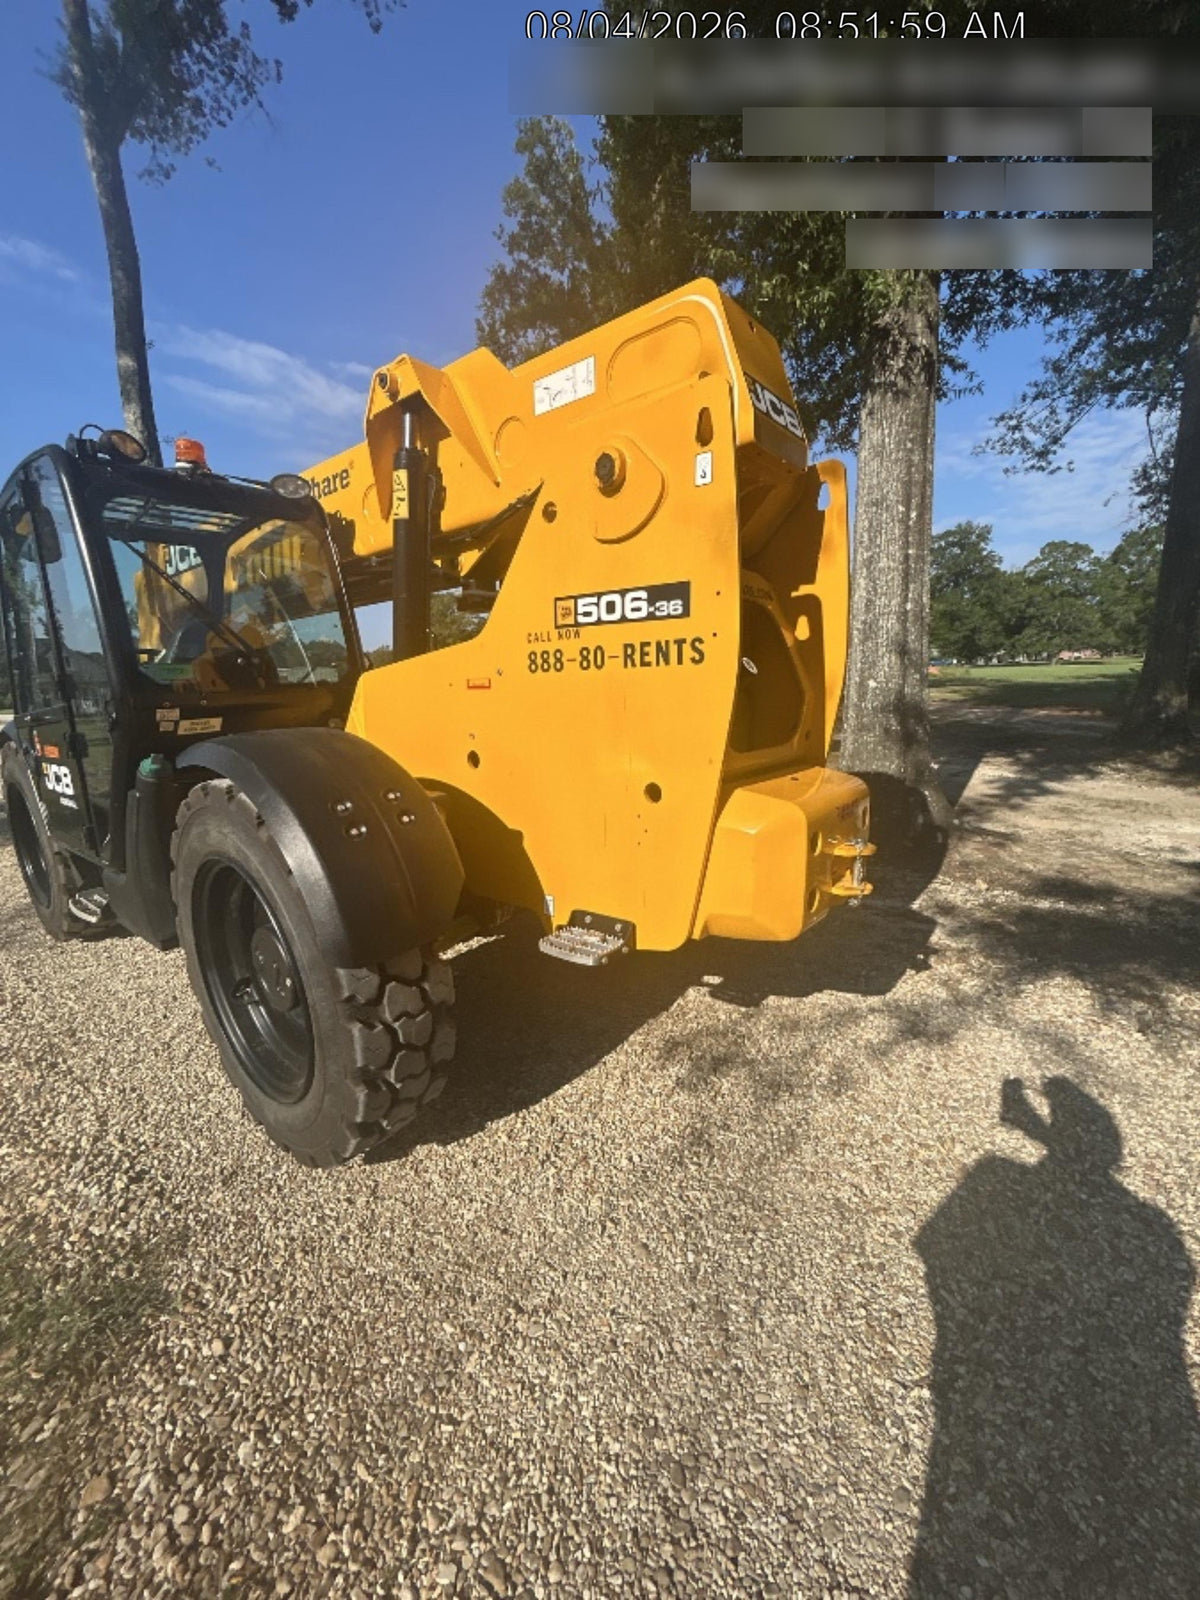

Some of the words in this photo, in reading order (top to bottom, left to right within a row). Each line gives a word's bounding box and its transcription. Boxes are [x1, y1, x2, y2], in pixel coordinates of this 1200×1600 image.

[750, 382, 803, 438] JCB
[309, 468, 350, 499] hare
[576, 590, 684, 623] 506-36
[526, 630, 552, 644] CALL
[557, 628, 581, 640] NOW
[527, 637, 706, 674] 888-80-RENTS
[45, 763, 75, 796] JCB
